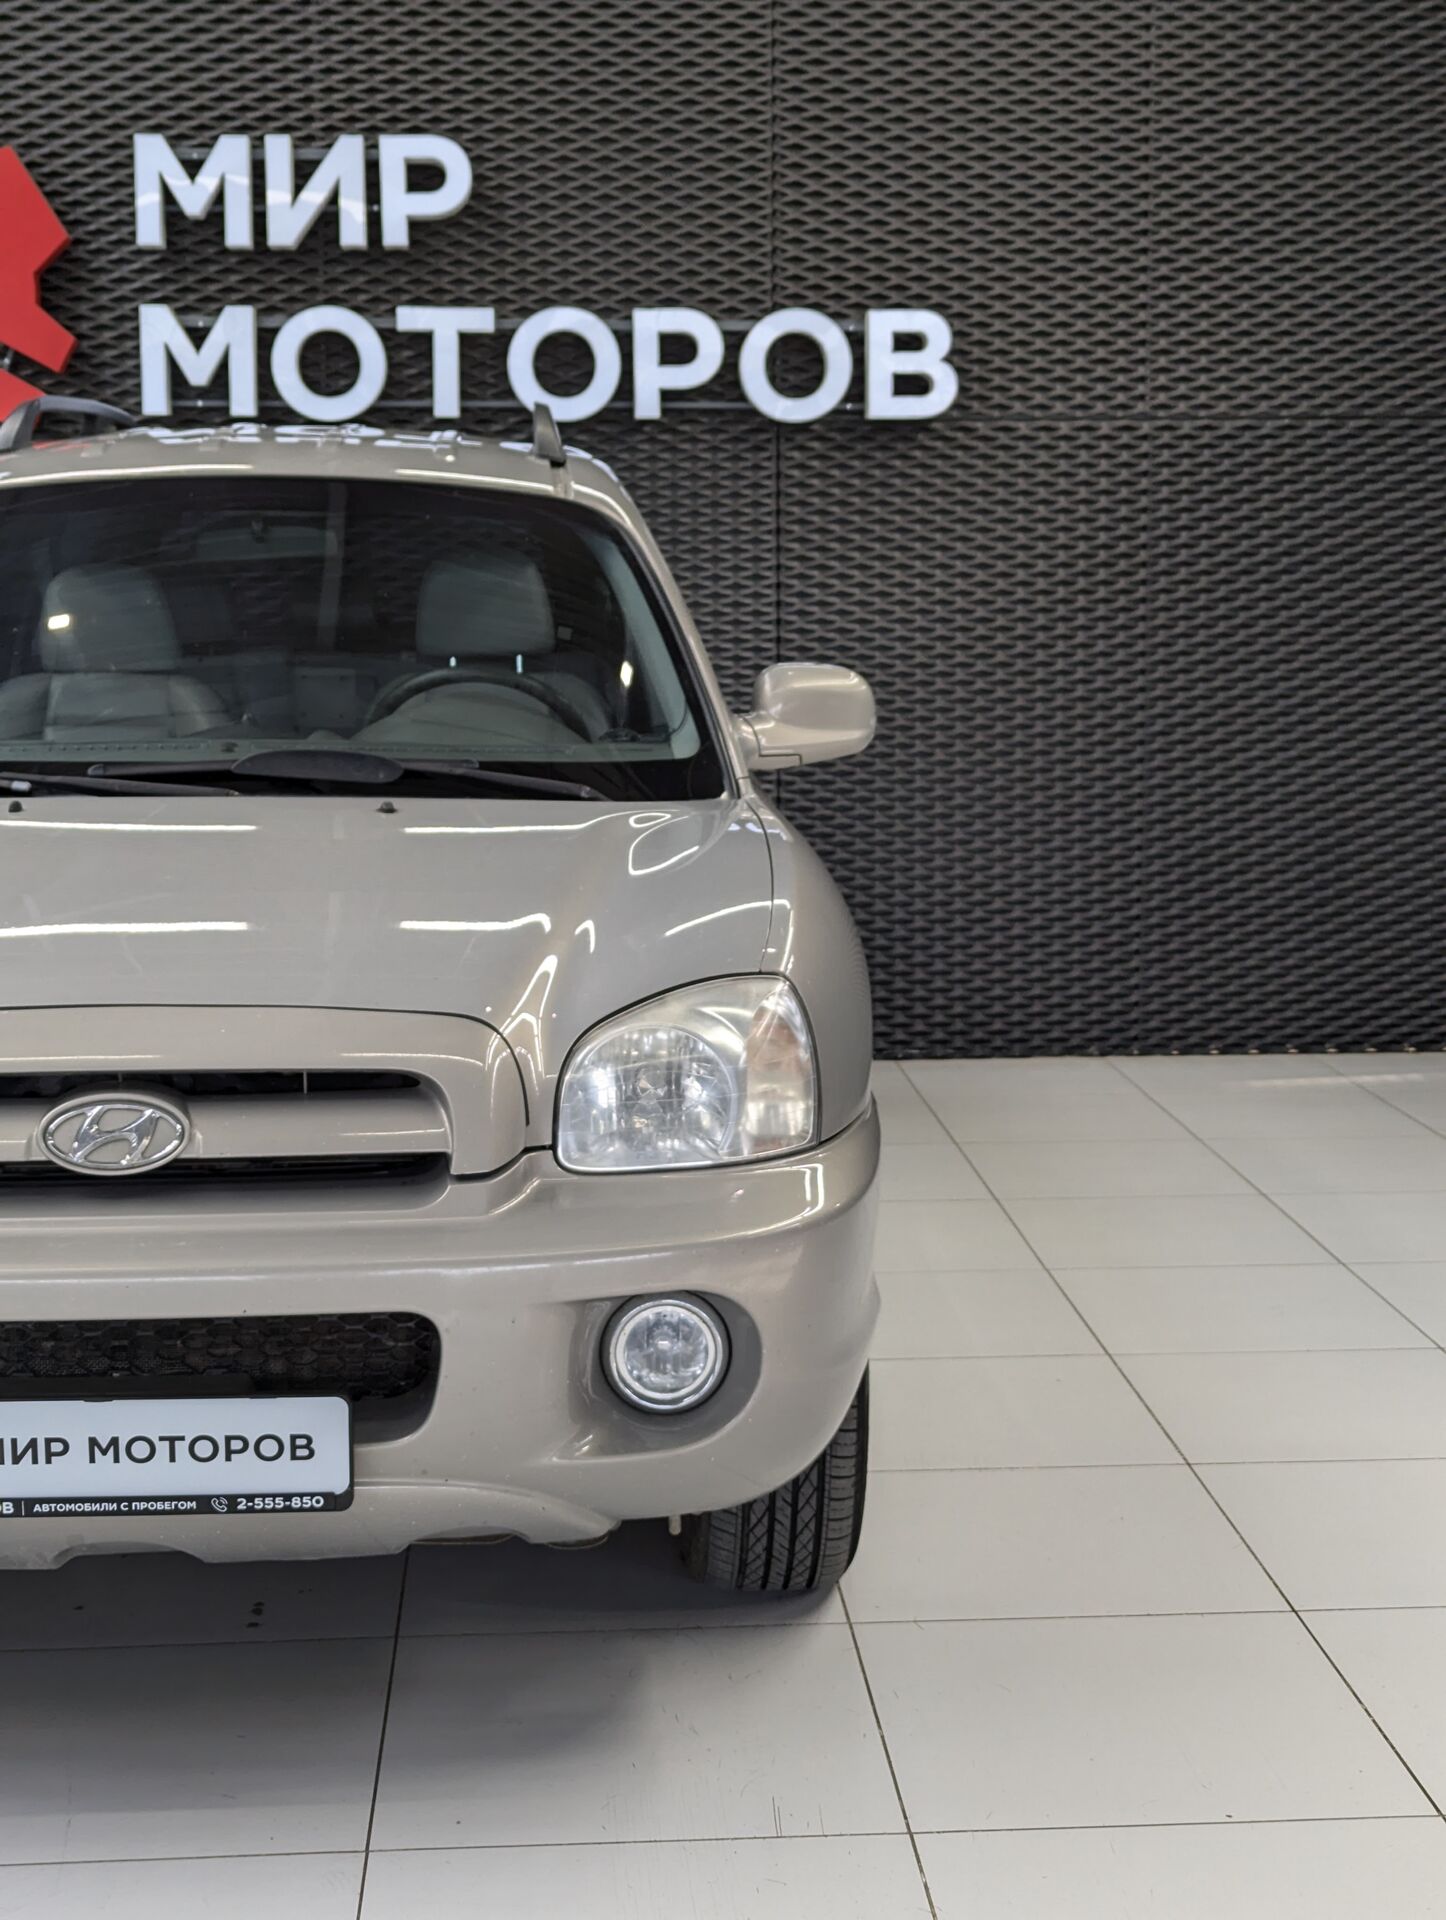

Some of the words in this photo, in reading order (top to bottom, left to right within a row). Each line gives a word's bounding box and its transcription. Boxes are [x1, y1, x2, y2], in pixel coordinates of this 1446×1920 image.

[133, 133, 474, 250] МИР
[138, 303, 960, 425] МОТОРОВ
[0, 1436, 70, 1466] ИР
[88, 1433, 316, 1465] МОТОРОВ
[0, 1501, 14, 1515] В
[33, 1502, 118, 1513] АВТОМОБИЛИ
[120, 1502, 129, 1512] С
[131, 1500, 197, 1511] ПРОБЕГОМ
[236, 1495, 325, 1510] 2-555-850
